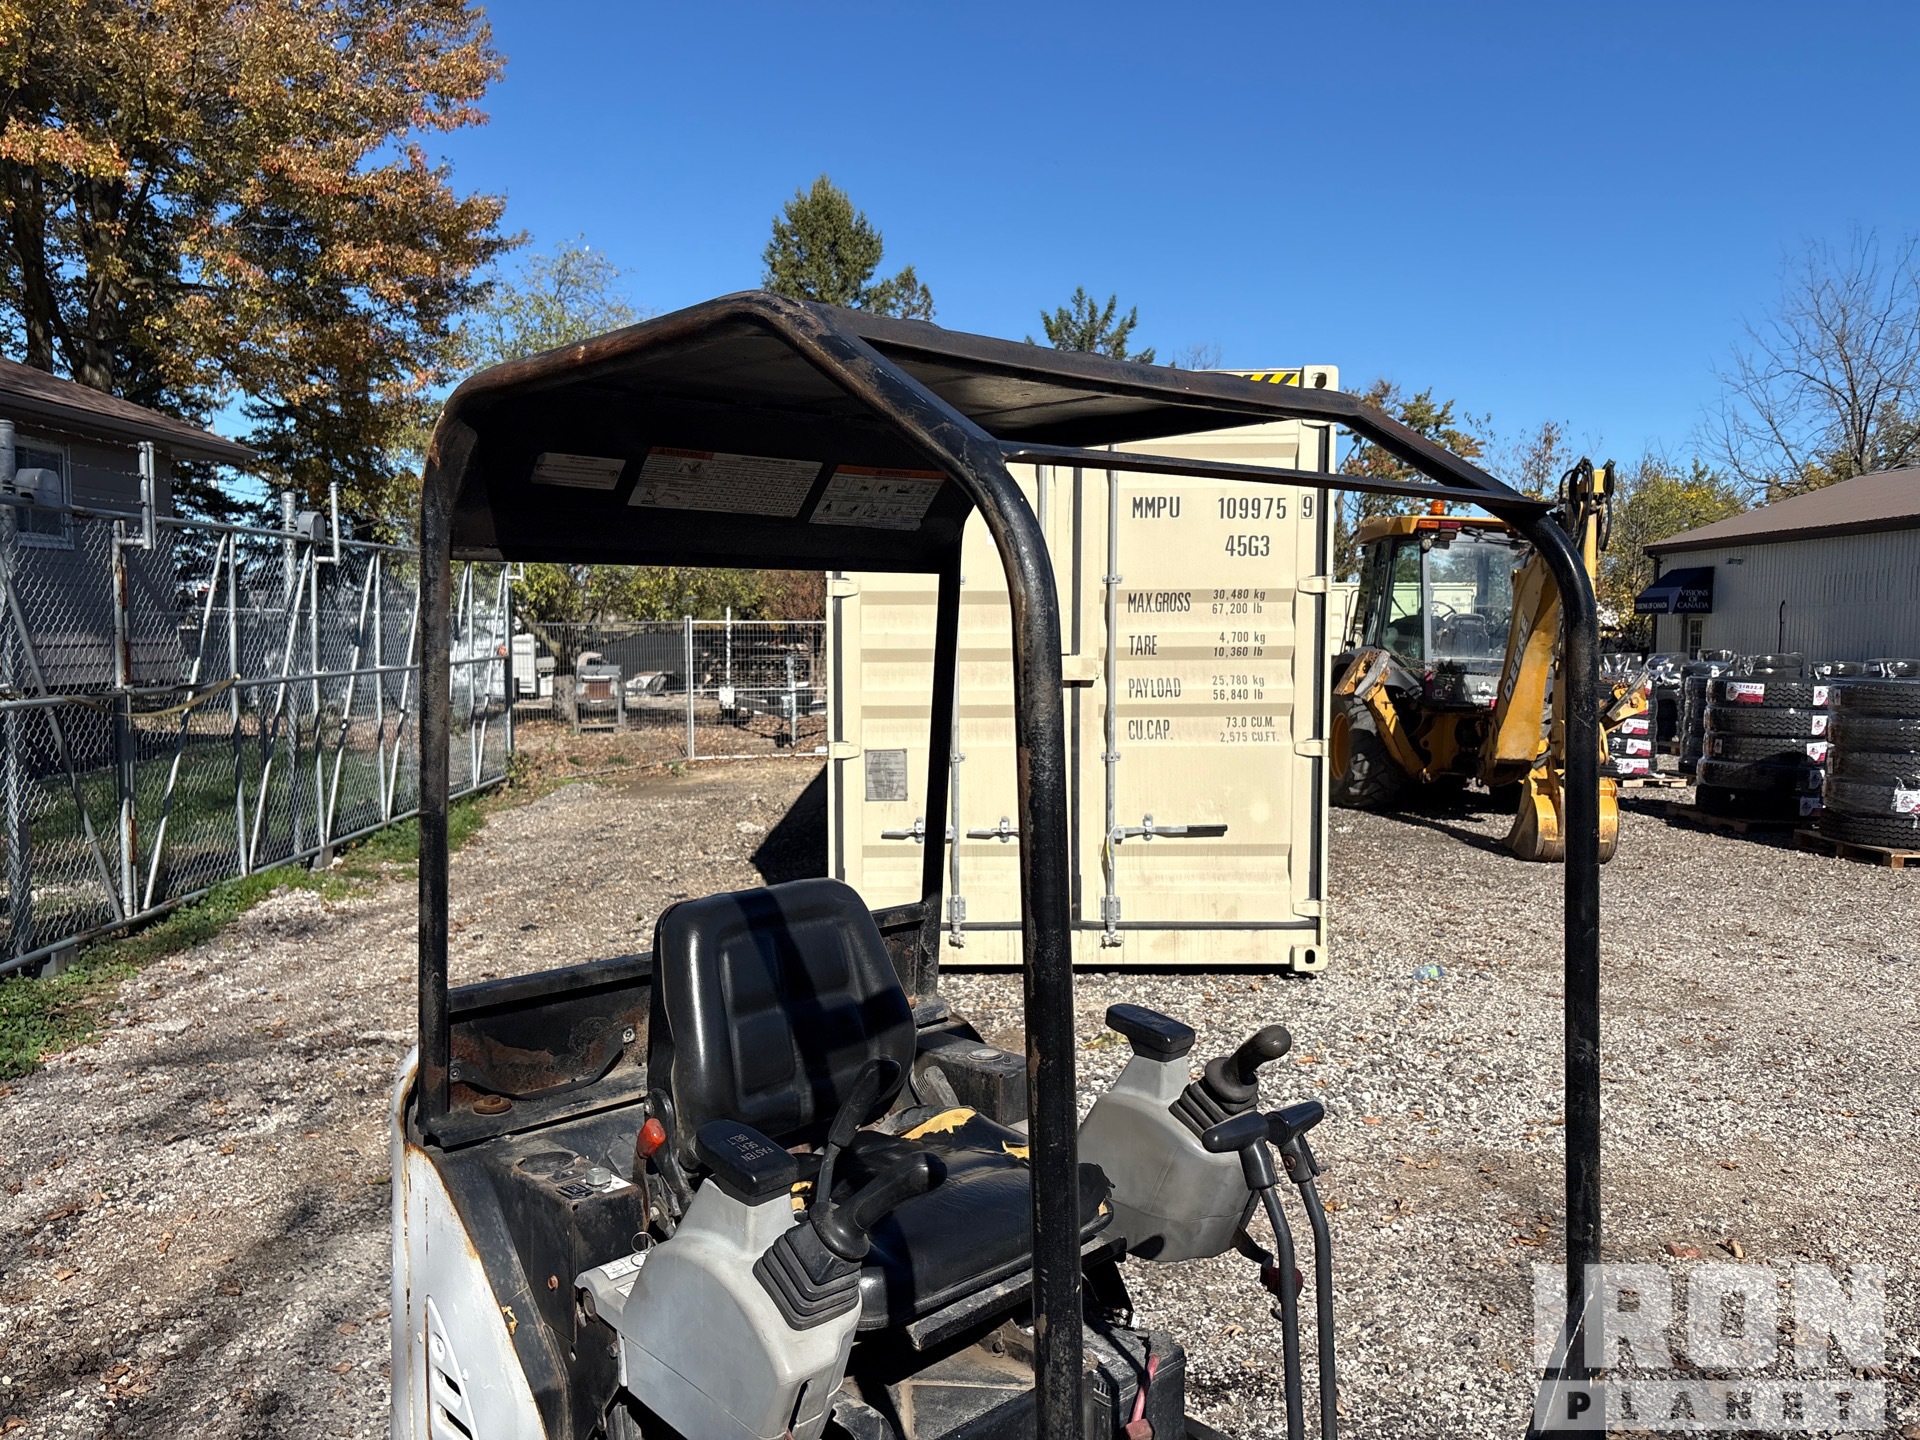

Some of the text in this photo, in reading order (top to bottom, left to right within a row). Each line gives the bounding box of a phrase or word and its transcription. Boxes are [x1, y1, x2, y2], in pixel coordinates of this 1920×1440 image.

[1132, 496, 1313, 519] MMPU 109975 9
[1225, 535, 1270, 557] 45G3
[1127, 592, 1192, 613] MAX.GROSS
[1213, 589, 1266, 601] 30,480 kg
[1212, 603, 1262, 615] 67,200 lb
[1129, 635, 1157, 656] TARE
[1219, 631, 1266, 645] 4,700 kg
[1213, 646, 1263, 658] 10,360 lb
[1503, 614, 1529, 703] DEERE
[1128, 677, 1181, 699] PAYLOAD
[1212, 674, 1265, 687] 25,780 kg
[1213, 689, 1263, 702] 56,840 lb
[1128, 719, 1173, 740] CU.CAP.
[1226, 716, 1275, 728] 73.0 CU.M.
[1220, 731, 1279, 744] 2,575 CU.FT.
[740, 1146, 774, 1162] FASTEN
